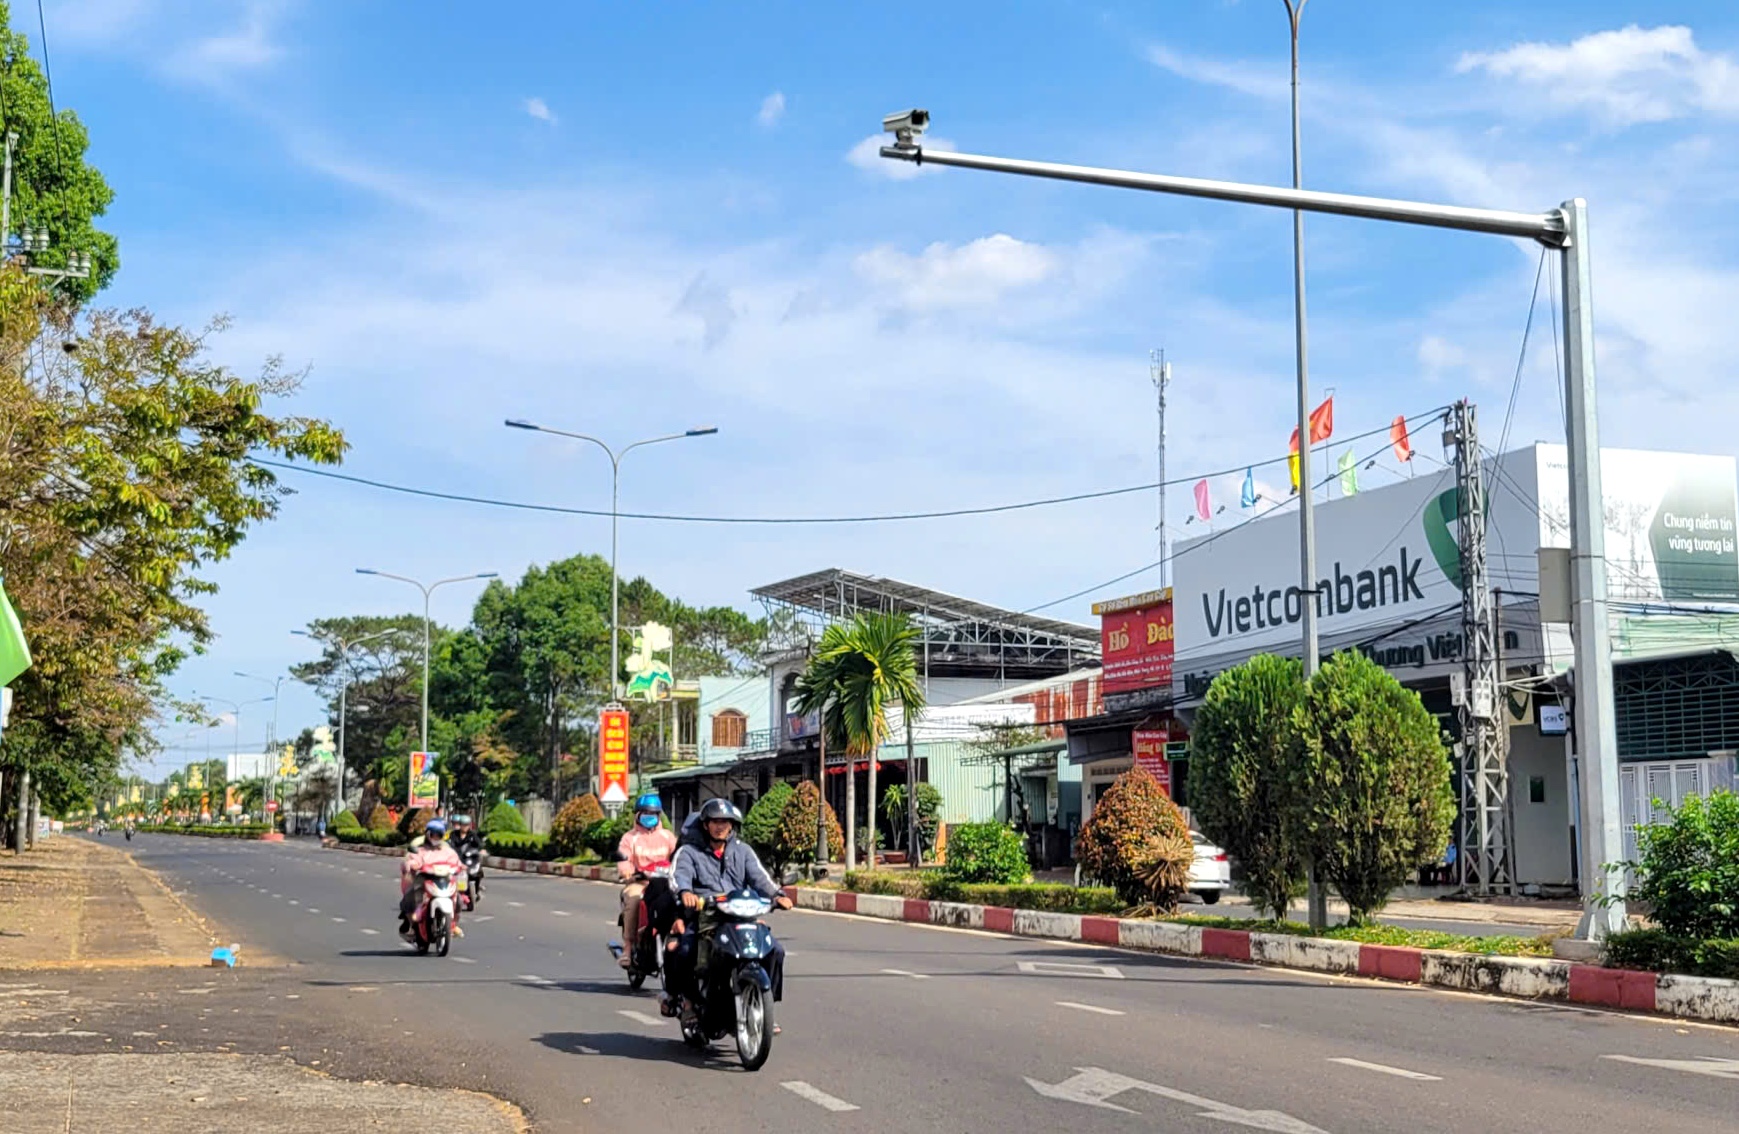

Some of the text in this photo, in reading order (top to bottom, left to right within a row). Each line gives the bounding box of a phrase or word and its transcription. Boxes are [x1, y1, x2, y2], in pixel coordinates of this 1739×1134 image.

[1664, 512, 1694, 532] Chung
[1668, 535, 1693, 554] vững
[1722, 537, 1734, 552] lai
